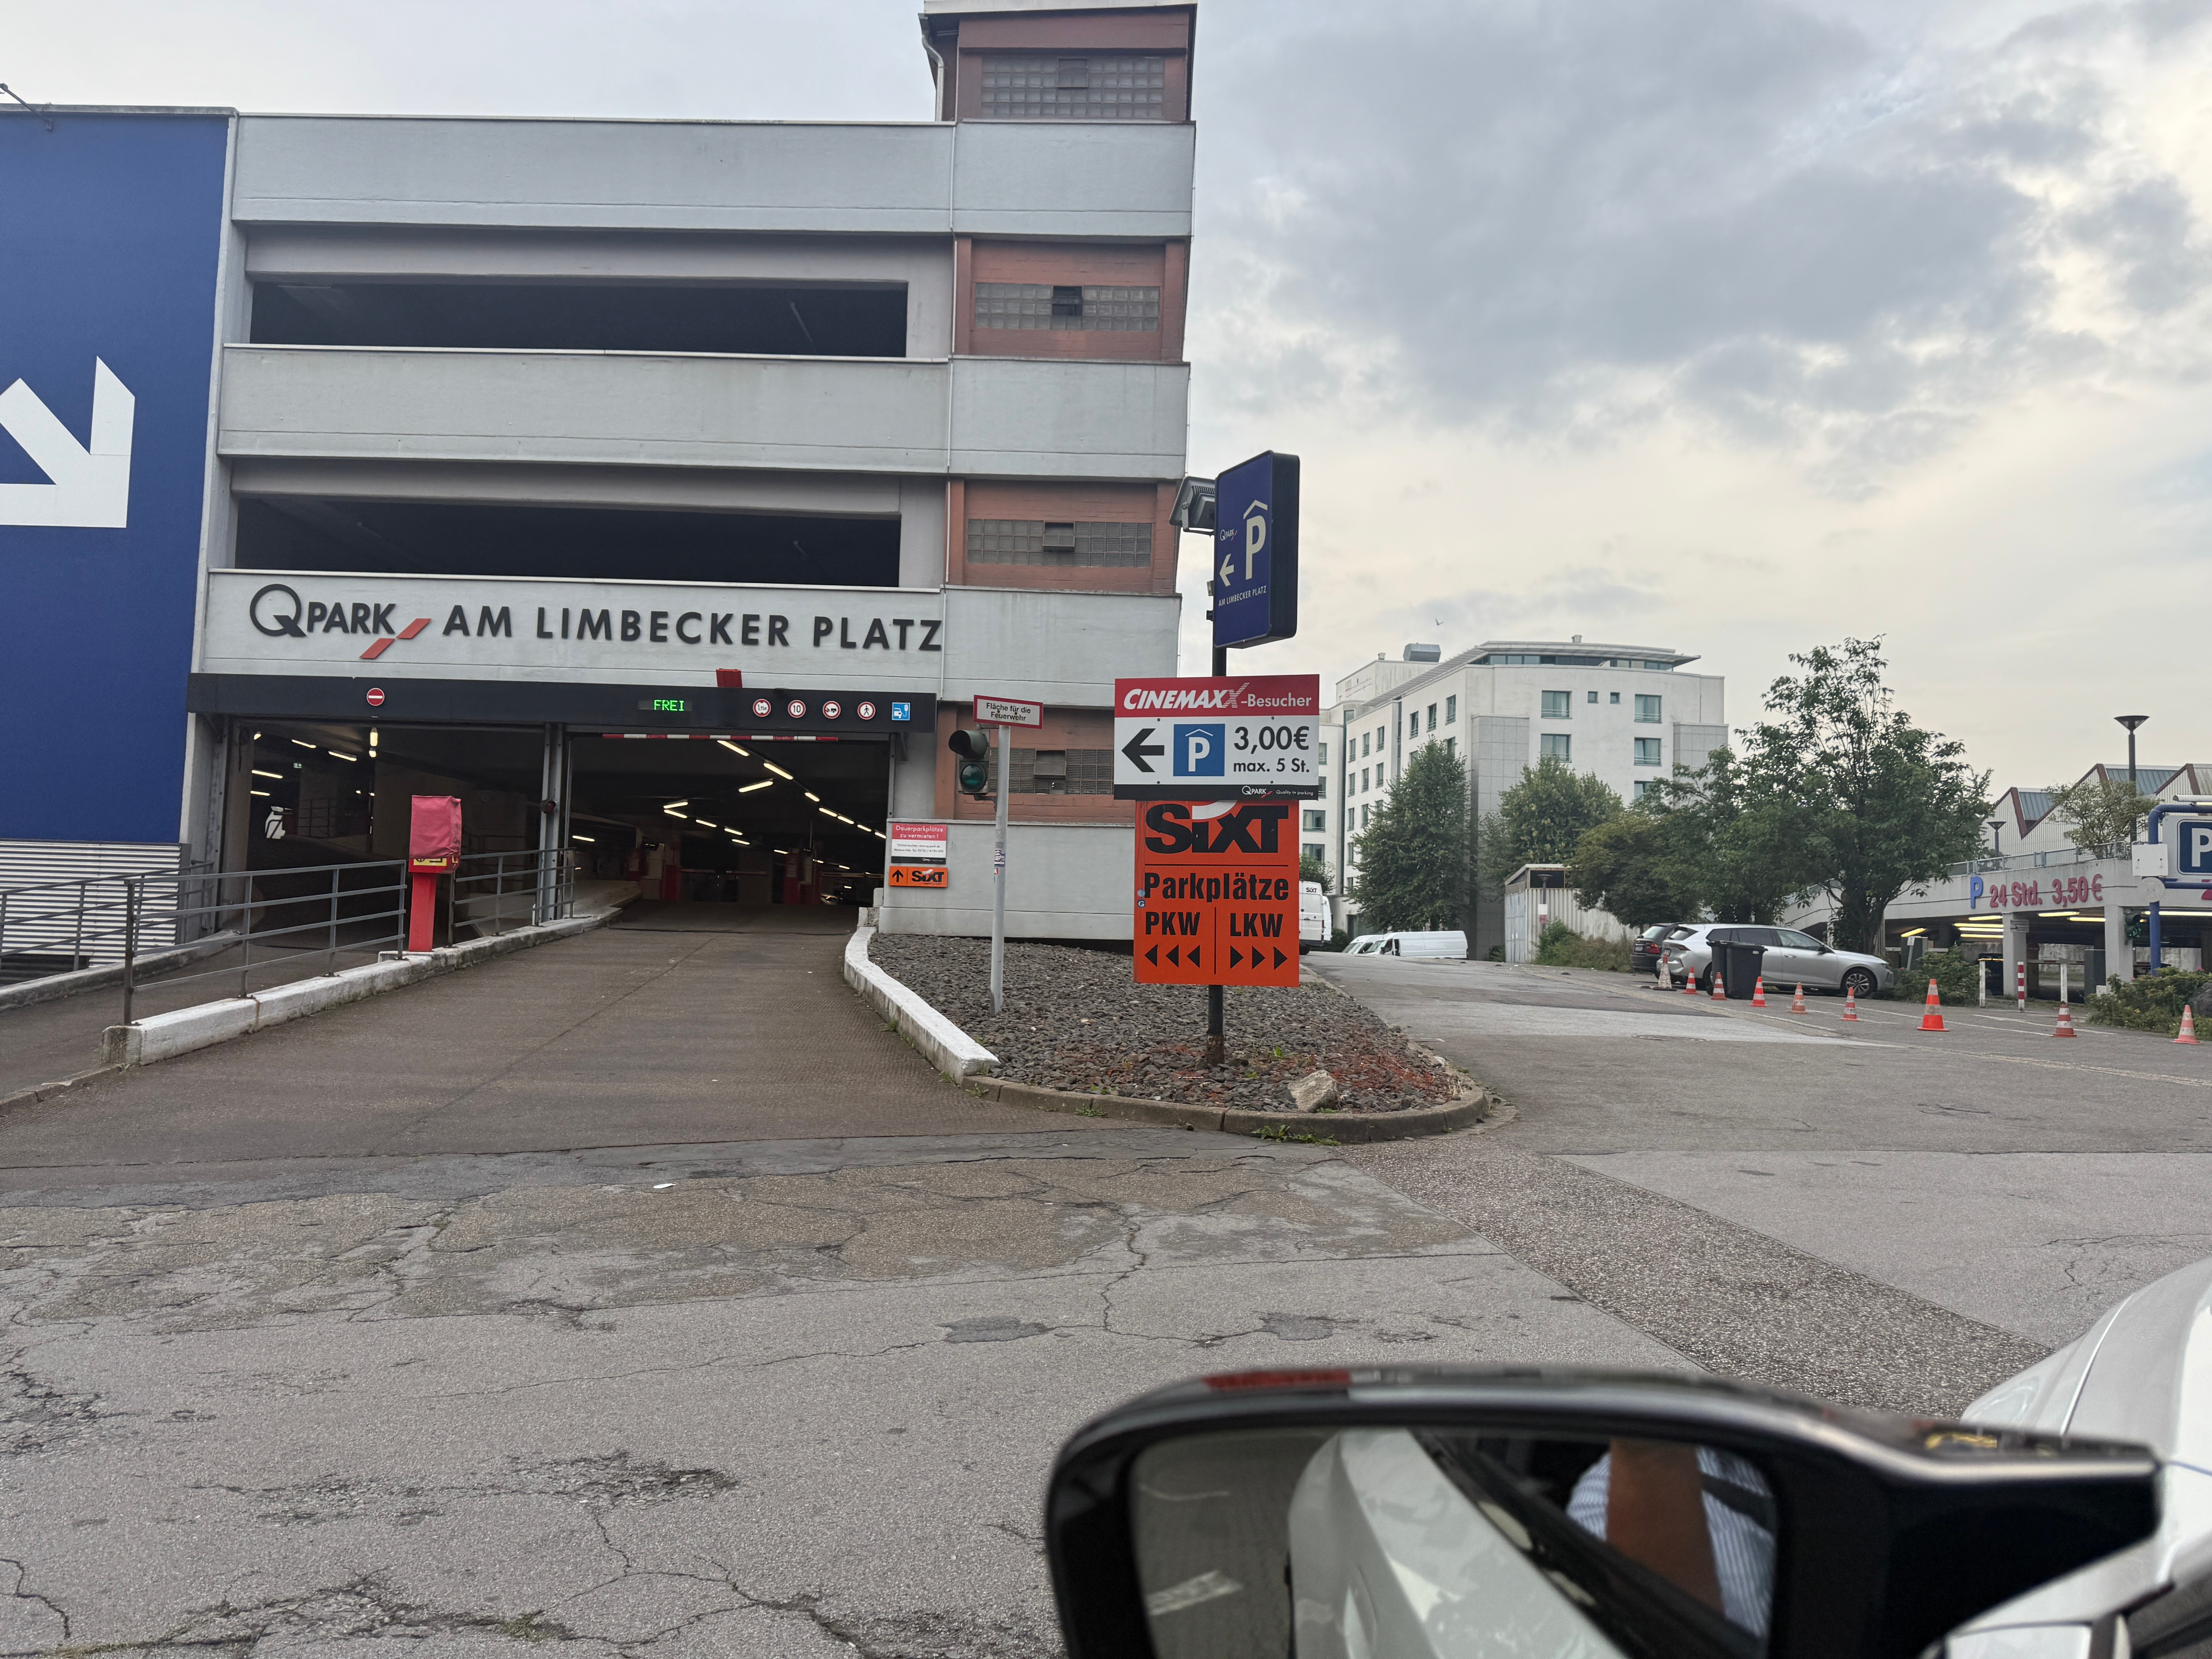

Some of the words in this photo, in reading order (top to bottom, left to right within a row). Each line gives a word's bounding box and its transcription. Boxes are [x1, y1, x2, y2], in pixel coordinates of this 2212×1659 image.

[1246, 515, 1266, 580] P
[1226, 590, 1251, 604] LIMBECKER
[1252, 586, 1267, 597] PLATZ
[442, 605, 513, 638] AM
[537, 606, 789, 647] LIMBECKER
[813, 616, 942, 651] PLATZ
[654, 699, 684, 711] FREI
[986, 702, 1008, 711] Fläche
[991, 711, 1026, 721] Feuerwehr
[1233, 725, 1309, 754] 3,00€
[1188, 737, 1210, 772] P
[1233, 761, 1270, 772] max.
[1276, 758, 1285, 772] 5
[1291, 757, 1310, 773] St.
[1144, 872, 1289, 902] Parkplätze
[1989, 884, 2007, 908] 24
[2011, 880, 2043, 907] Std.
[1145, 911, 1200, 936] PKW
[1230, 913, 1283, 937] LKW
